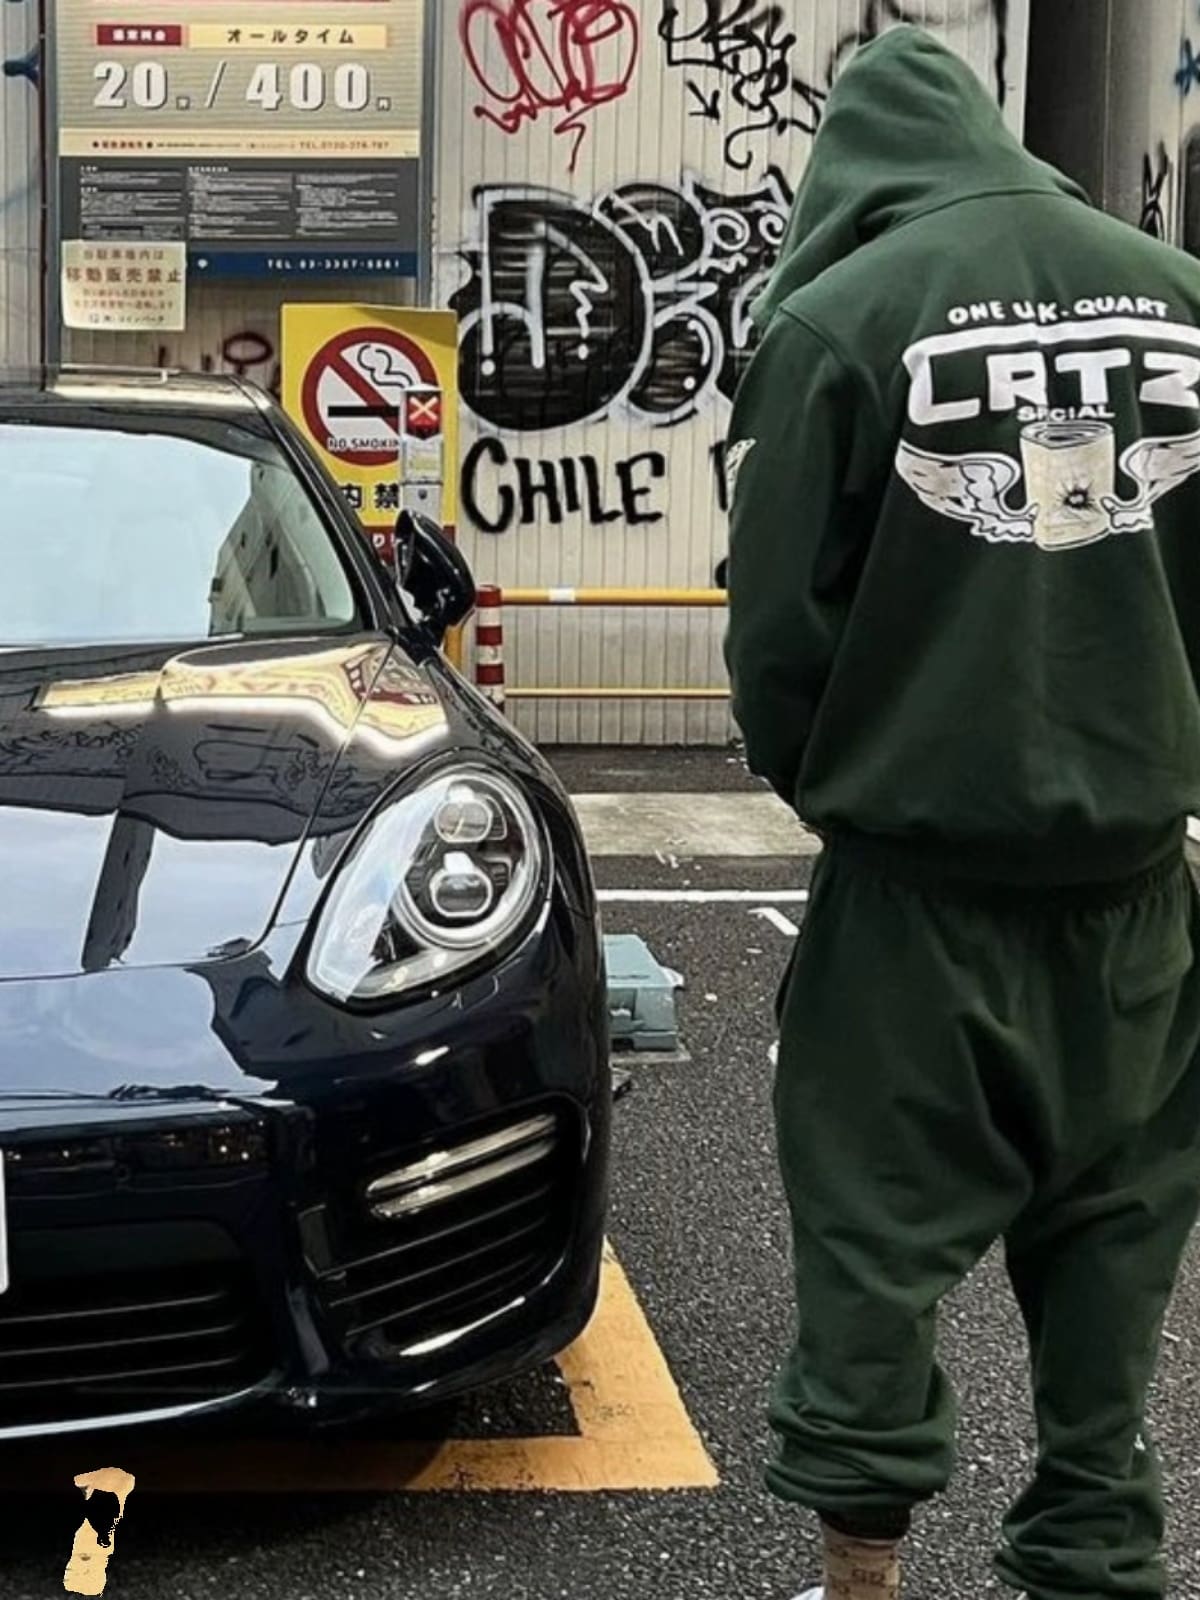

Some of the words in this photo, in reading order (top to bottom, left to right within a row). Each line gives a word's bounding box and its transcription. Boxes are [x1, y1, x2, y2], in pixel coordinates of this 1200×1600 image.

[227, 28, 355, 45] オールタイム
[948, 300, 1005, 325] ONE
[328, 437, 348, 449] NO
[461, 436, 667, 534] CHILE
